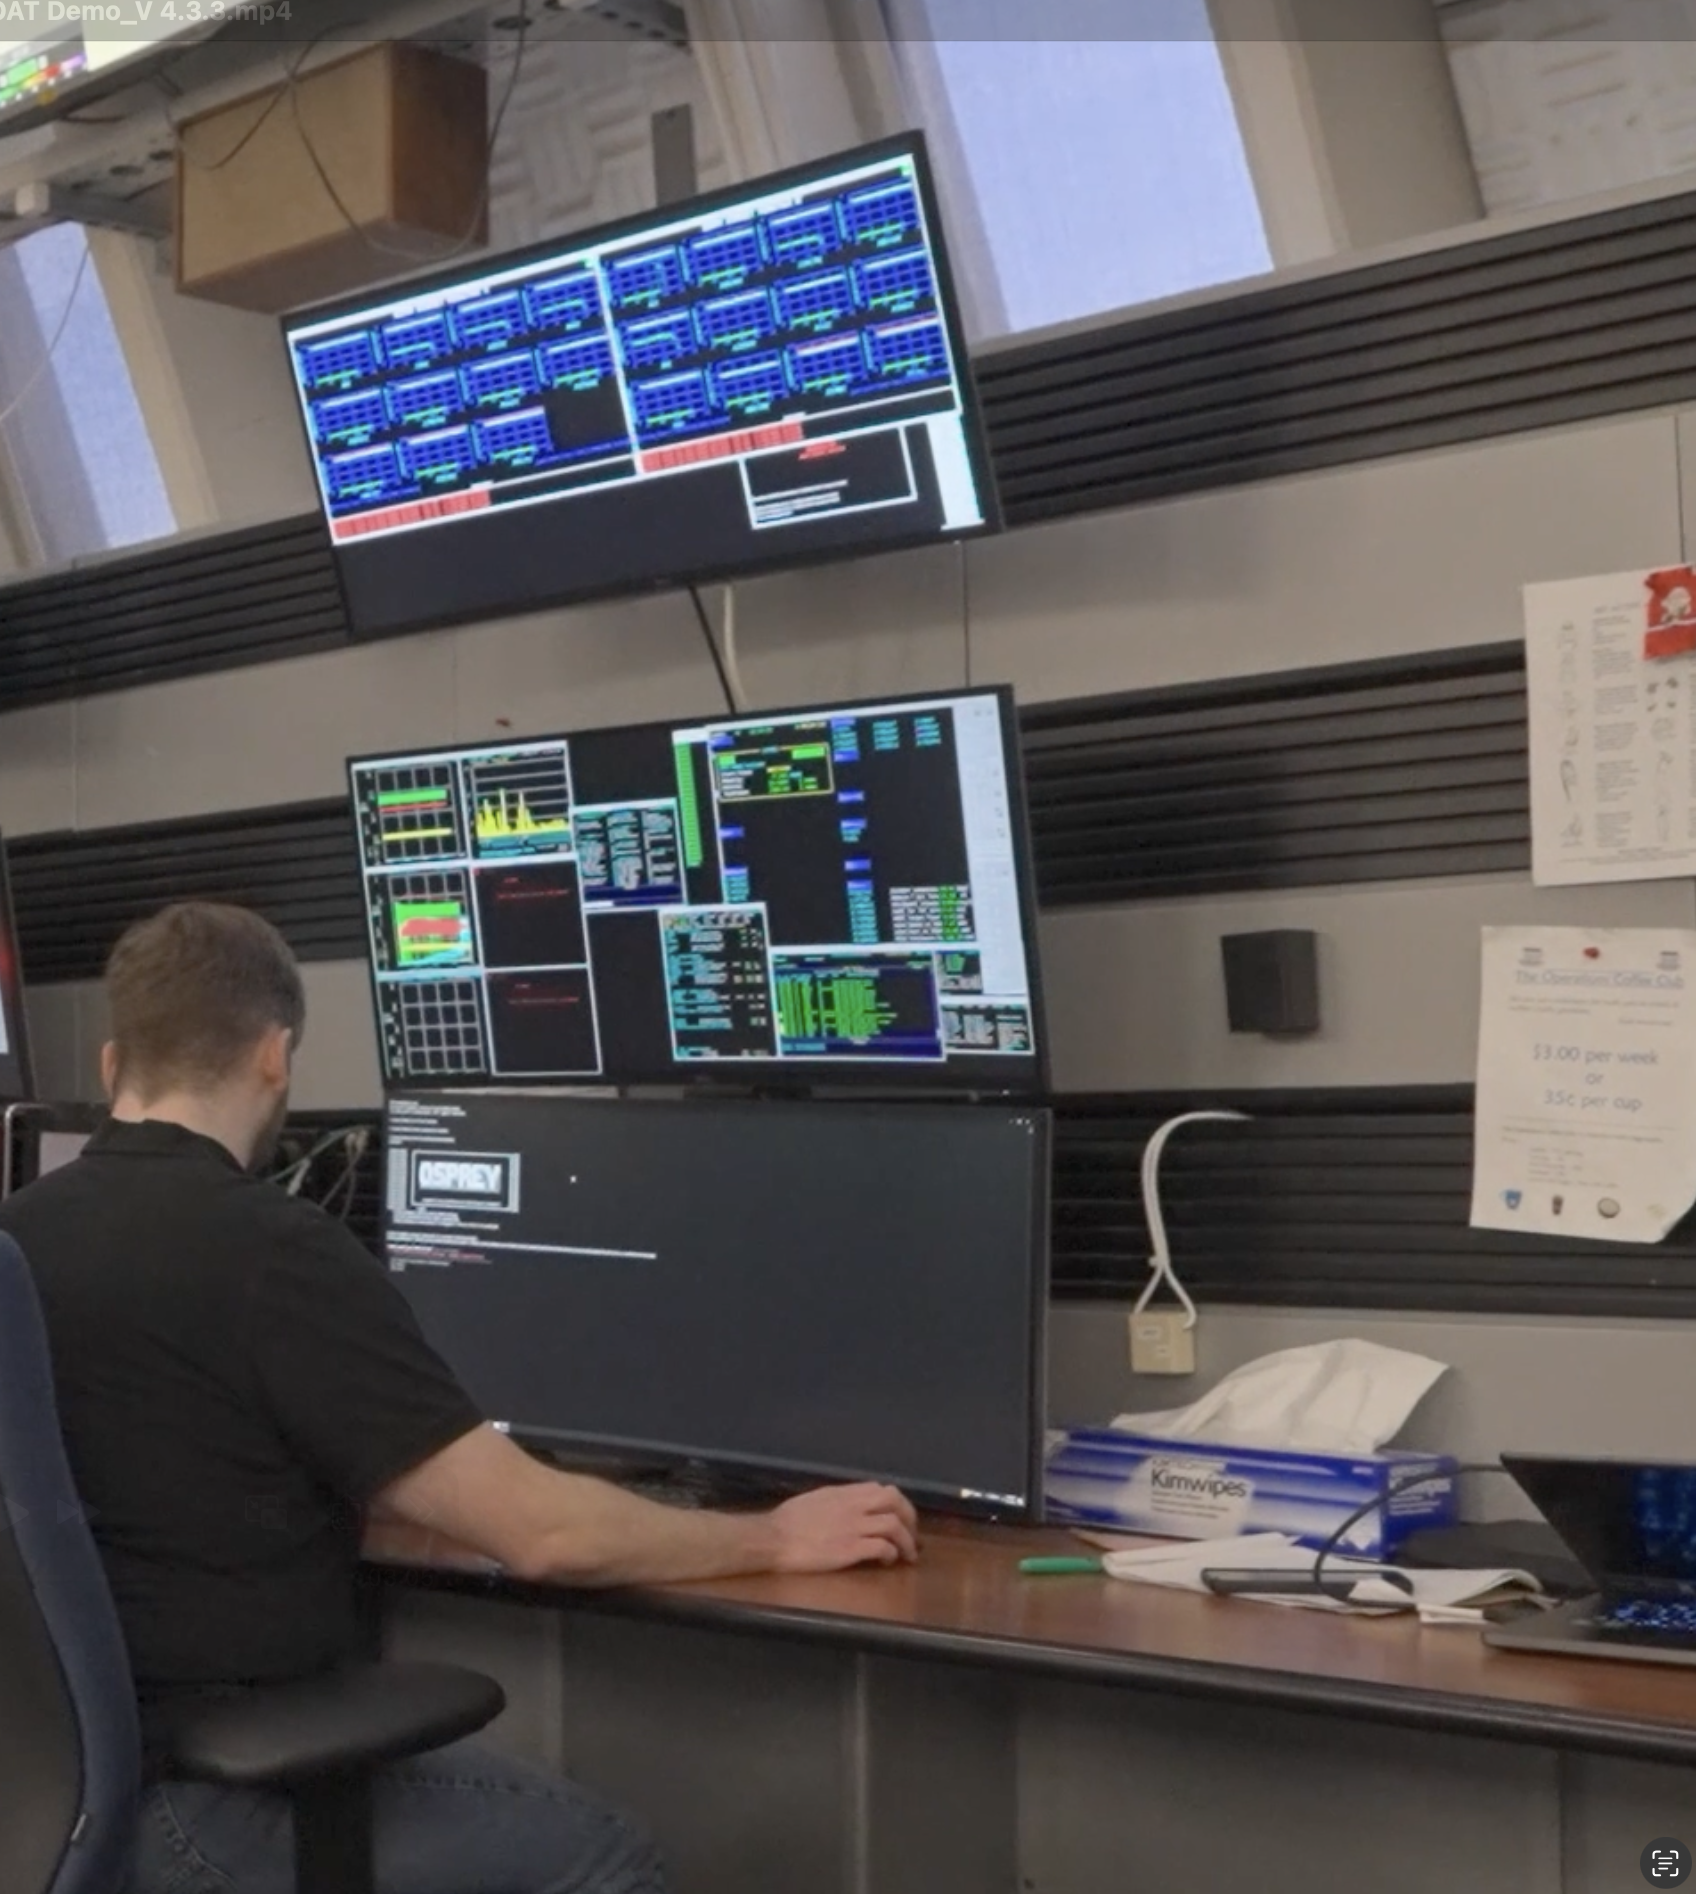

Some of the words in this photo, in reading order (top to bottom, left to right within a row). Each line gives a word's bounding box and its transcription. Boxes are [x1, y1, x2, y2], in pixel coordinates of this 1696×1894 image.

[1533, 1043, 1581, 1061] $3.00
[1585, 1051, 1612, 1064] per
[1617, 1049, 1659, 1064] week
[1585, 1073, 1604, 1085] or
[1581, 1096, 1608, 1110] per
[1613, 1096, 1643, 1113] cup
[418, 1160, 502, 1195] OSPREY
[1151, 1468, 1247, 1498] Kimwipes
